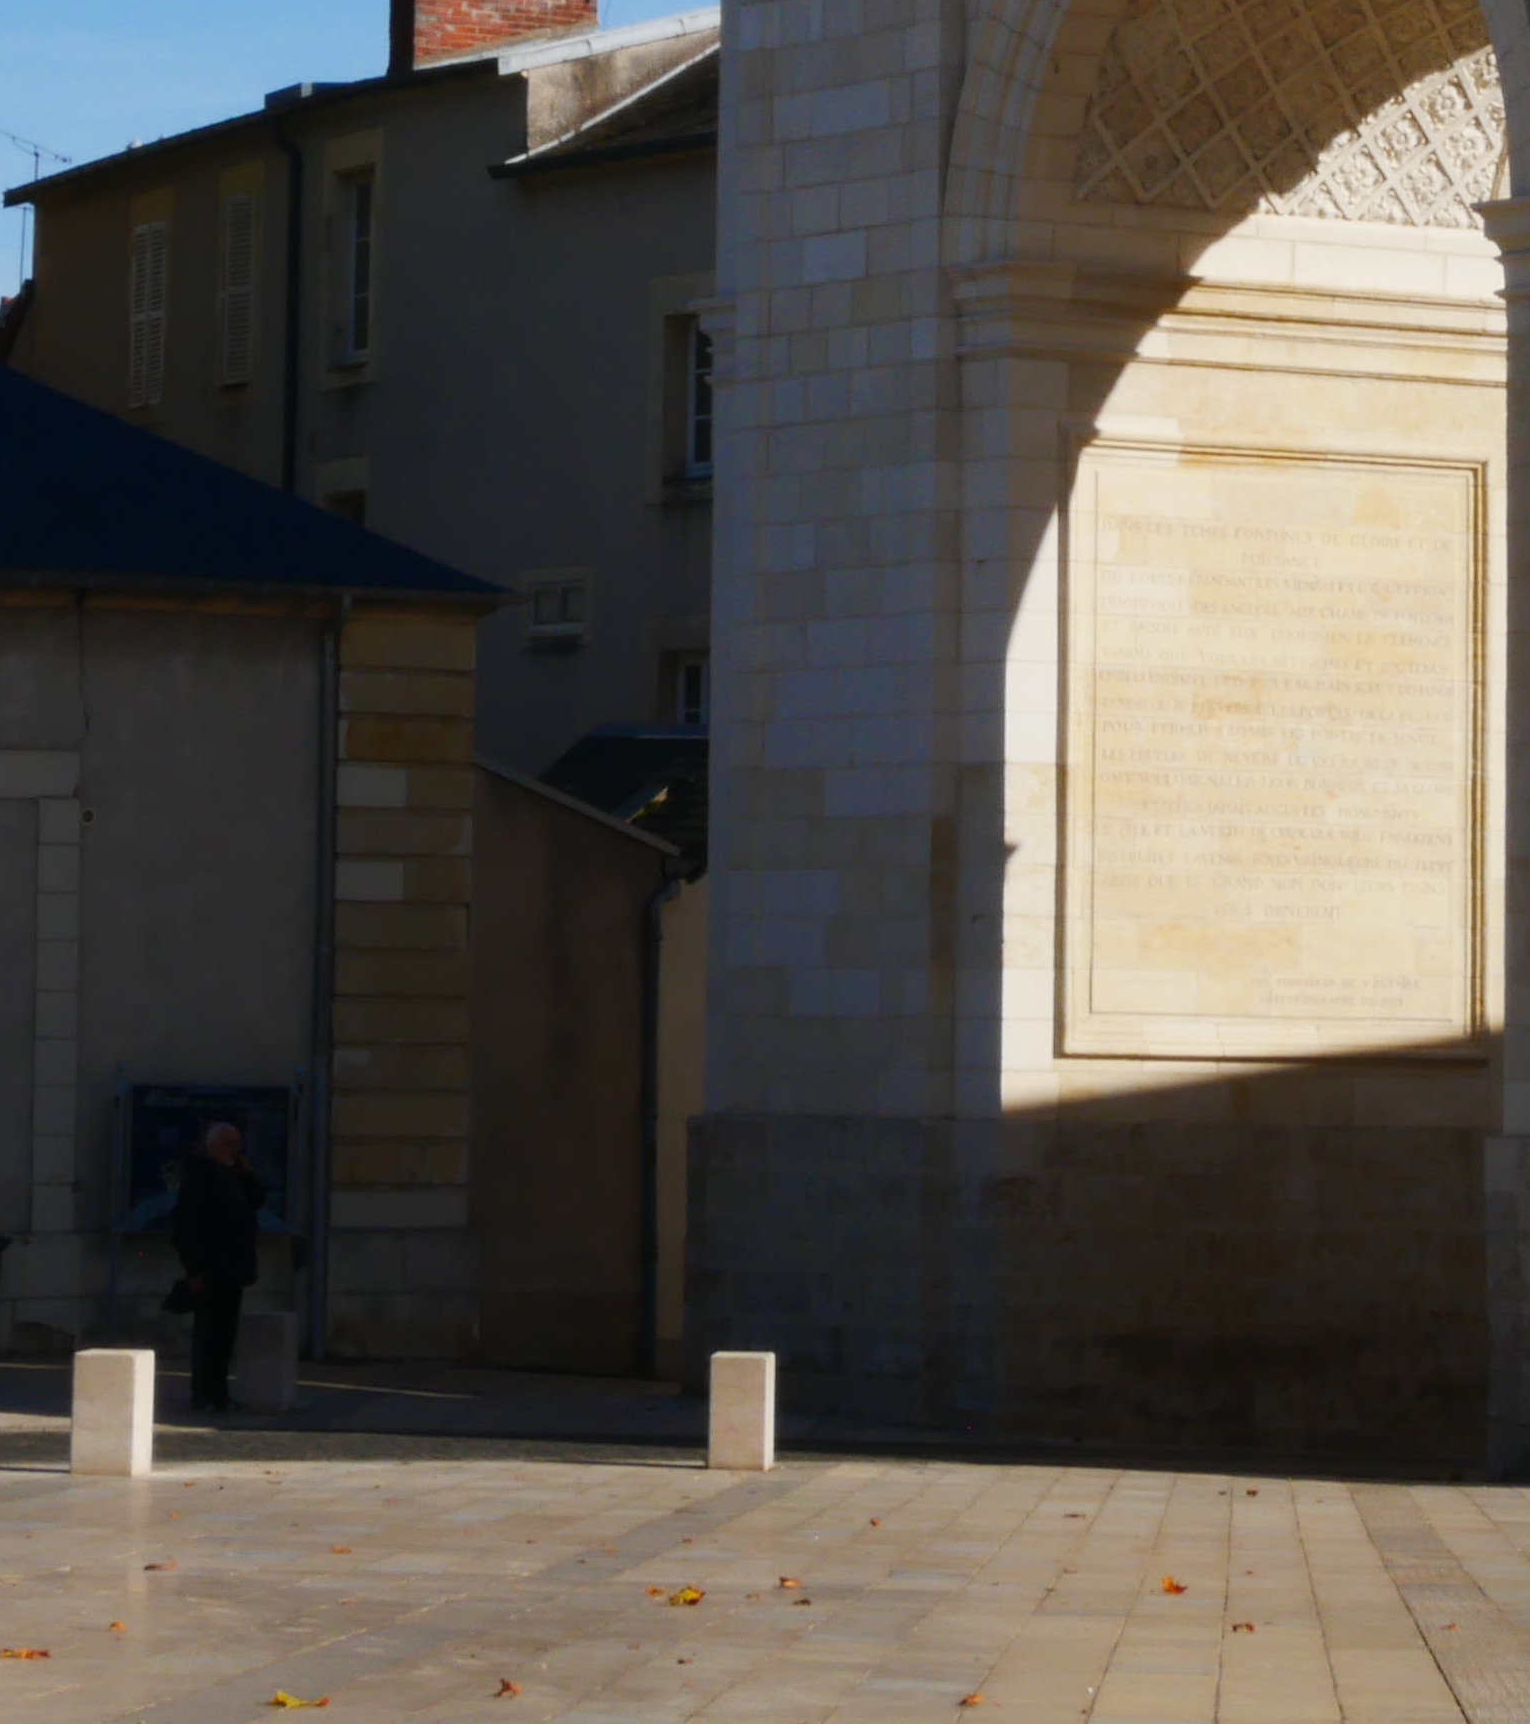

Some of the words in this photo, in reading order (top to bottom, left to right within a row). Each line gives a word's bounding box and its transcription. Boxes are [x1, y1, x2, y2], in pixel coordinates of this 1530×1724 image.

[1180, 524, 1226, 539] TEMPS
[1321, 533, 1340, 546] DE
[1350, 535, 1400, 549] GLOIRE
[1408, 537, 1424, 550] ET
[1433, 539, 1450, 551] DE
[1131, 572, 1175, 586] LOUIS
[1193, 600, 1218, 613] DES
[1289, 606, 1317, 618] AUX
[1103, 619, 1119, 632] ET
[1189, 625, 1221, 637] AVEC
[1231, 626, 1257, 639] EUX
[1357, 632, 1375, 646] LA
[1159, 649, 1186, 662] QUE
[1355, 660, 1373, 672] ET
[1102, 720, 1143, 734] POUR
[1102, 747, 1125, 760] LES
[1197, 751, 1214, 764] DE
[1179, 825, 1196, 838] LA
[1387, 858, 1409, 871] DU
[1147, 875, 1177, 888] QUE
[1271, 878, 1303, 891] NOM
